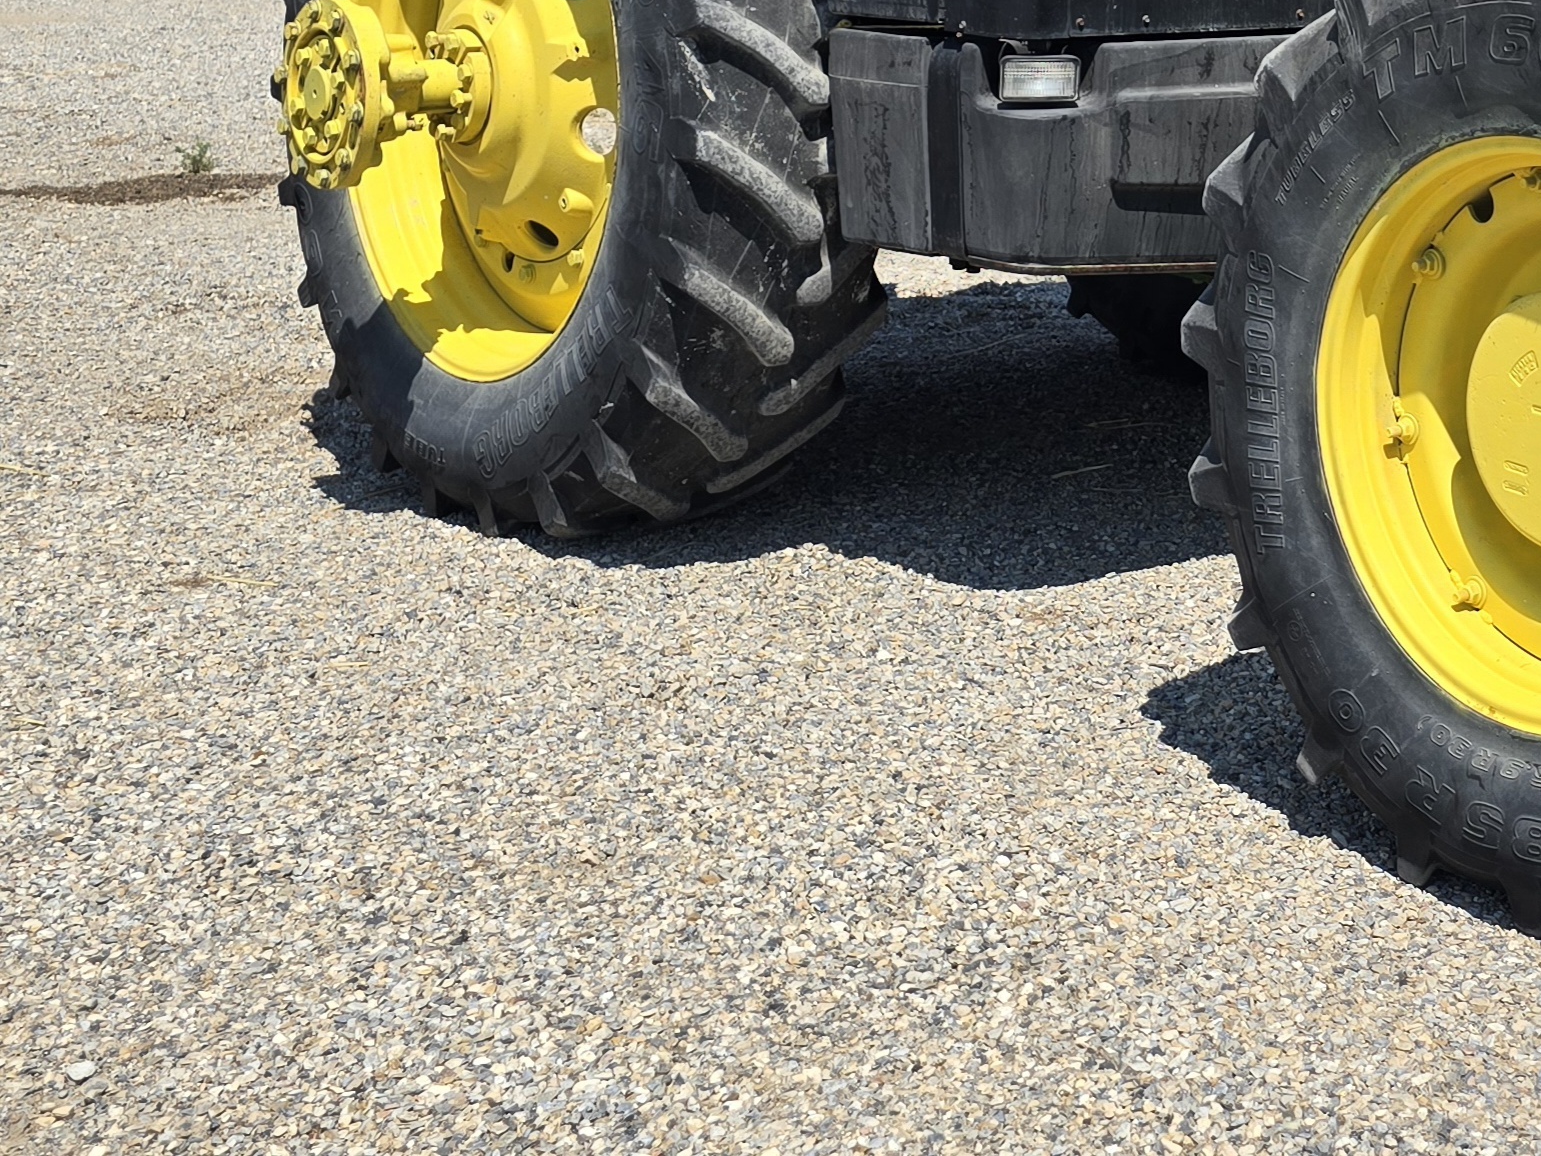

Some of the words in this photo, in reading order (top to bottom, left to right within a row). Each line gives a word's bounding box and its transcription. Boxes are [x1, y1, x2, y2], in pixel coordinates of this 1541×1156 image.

[1362, 14, 1467, 102] TM
[1275, 88, 1355, 208] TUBELESS
[473, 282, 638, 482] TRELLEBORG
[1246, 250, 1283, 557] TRELLEBORG
